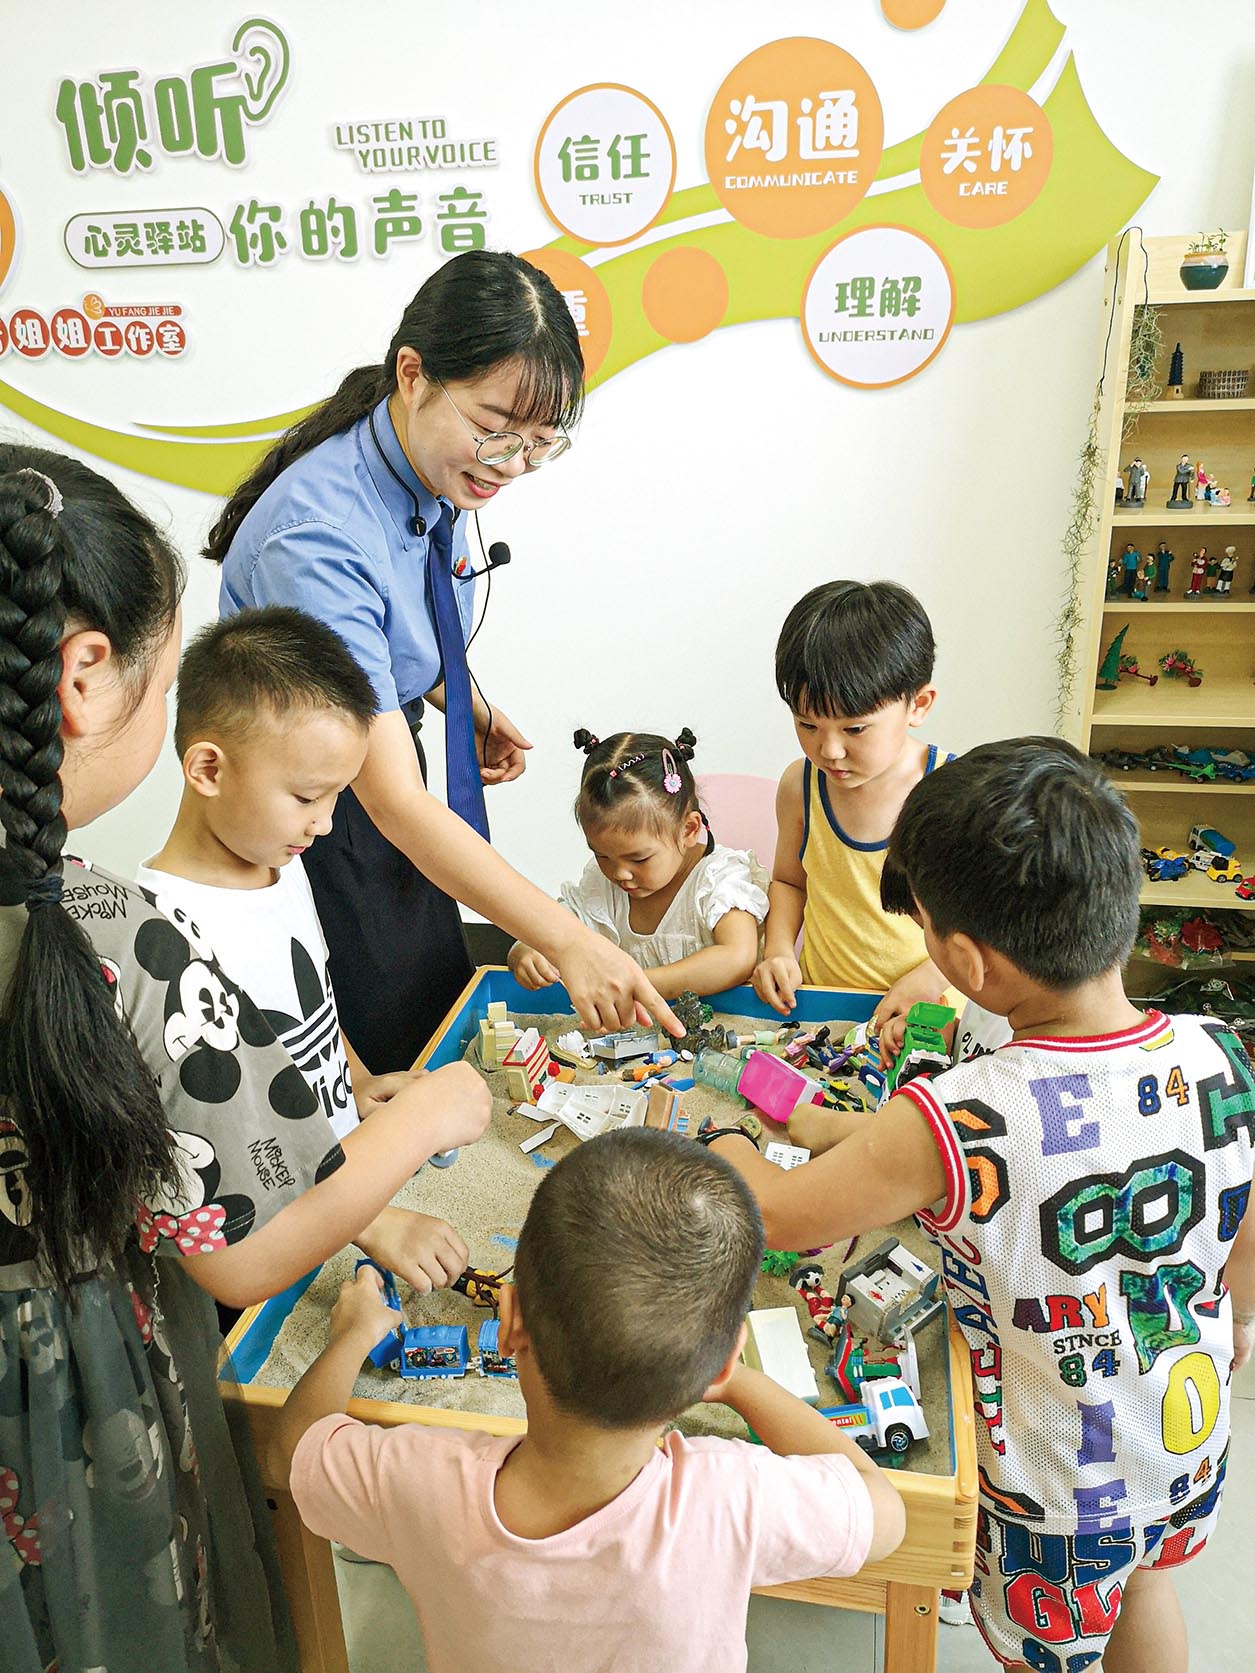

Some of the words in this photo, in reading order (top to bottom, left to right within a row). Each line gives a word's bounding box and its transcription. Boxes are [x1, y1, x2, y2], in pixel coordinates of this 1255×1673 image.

[56, 61, 247, 173] 倾听
[336, 121, 413, 145] LISTEN
[418, 119, 446, 140] TO
[724, 89, 860, 163] 沟通
[557, 133, 651, 183] 信任
[940, 126, 1035, 174] 关怀
[725, 170, 858, 189] COMMUNICATE
[958, 181, 1008, 196] CARE
[579, 192, 633, 206] TRUST
[84, 219, 207, 257] 心灵驿站
[229, 186, 489, 265] 你的声音
[108, 307, 121, 316] YU
[122, 306, 147, 316] FANG
[148, 306, 160, 315] JIE
[162, 305, 175, 315] JIE
[834, 276, 923, 319] 理解
[0, 317, 184, 352] 姐姐工作室
[819, 328, 934, 343] UNDERSTAND
